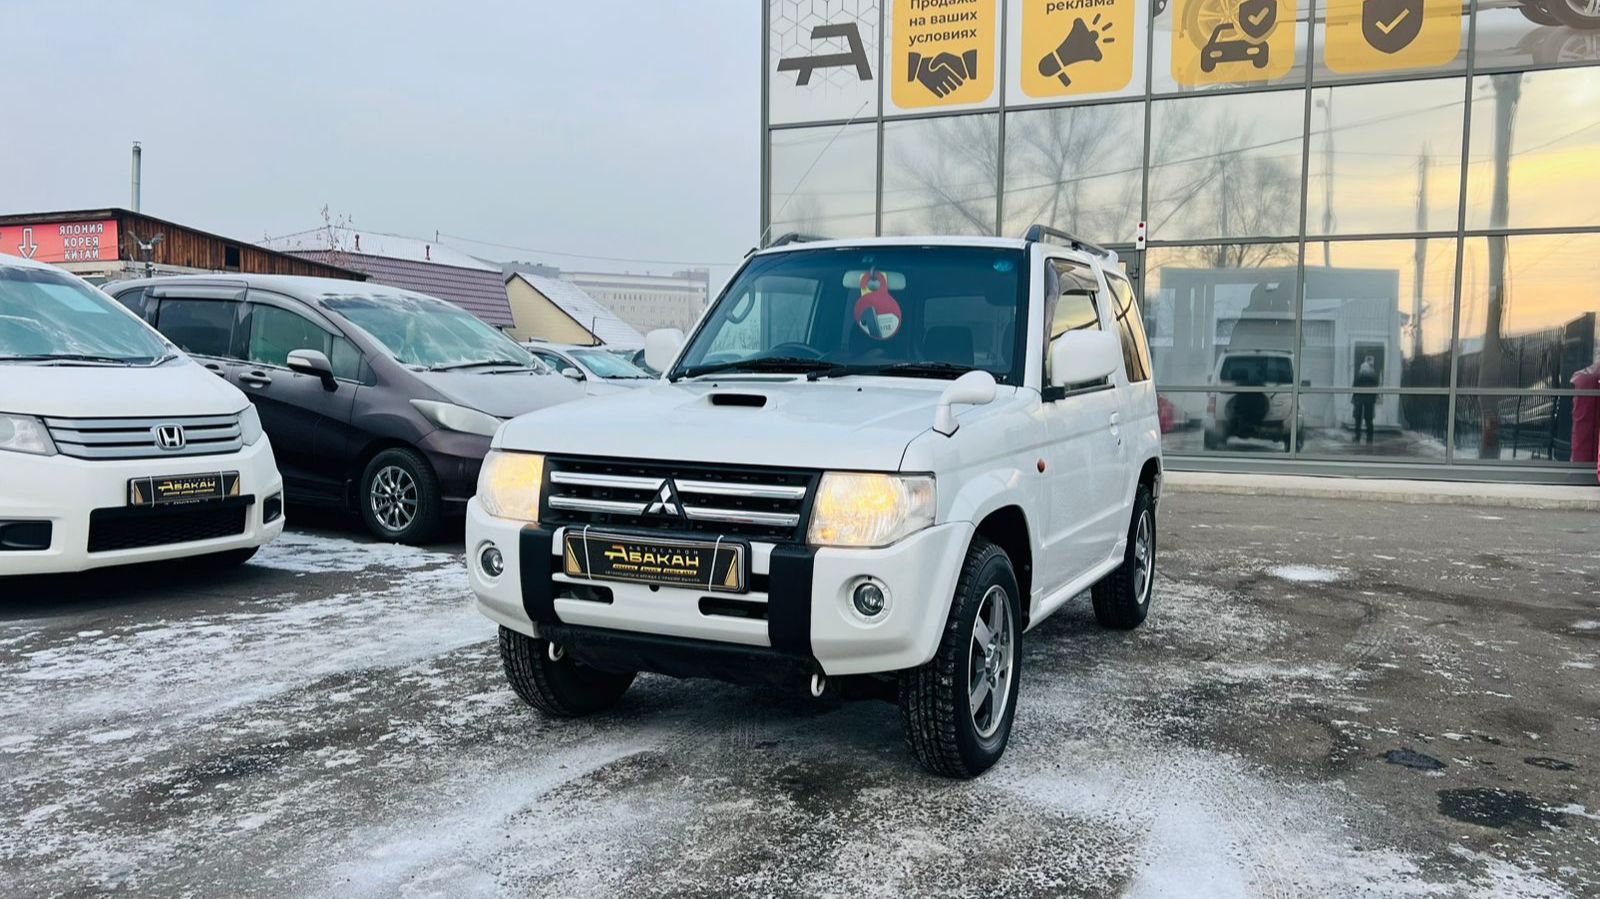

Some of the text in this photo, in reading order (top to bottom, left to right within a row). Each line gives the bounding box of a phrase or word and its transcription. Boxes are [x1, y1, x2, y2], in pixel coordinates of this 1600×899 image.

[1046, 0, 1115, 15] реклама
[909, 11, 978, 27] на ваших
[908, 29, 977, 47] условиях
[59, 224, 103, 235] ЯПОНИЯ
[64, 237, 99, 247] КОРЕЯ
[64, 248, 99, 260] КИТАЙ
[604, 544, 700, 567] АБАКАН
